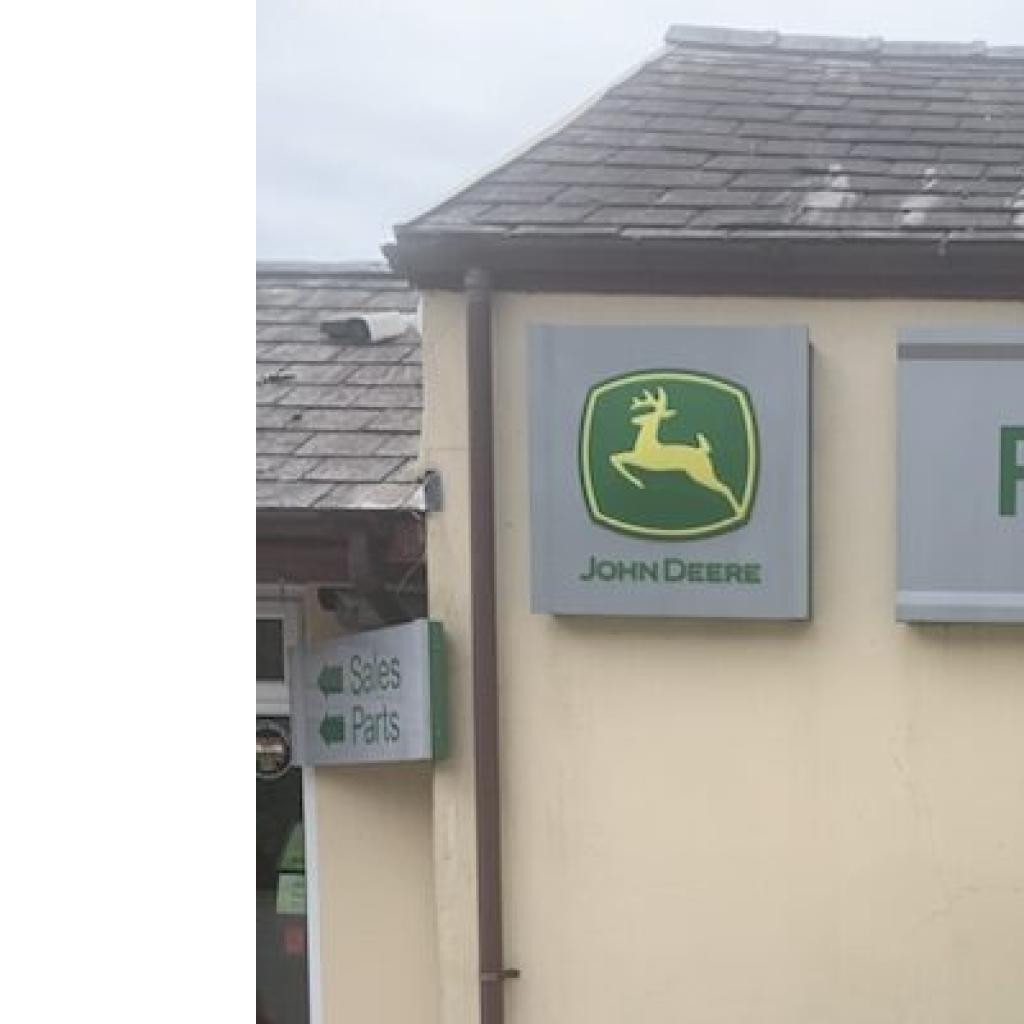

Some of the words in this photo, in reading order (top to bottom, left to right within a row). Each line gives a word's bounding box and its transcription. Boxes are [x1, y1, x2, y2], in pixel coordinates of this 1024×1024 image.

[580, 556, 659, 582] JOHN
[664, 557, 761, 584] DEERE
[350, 654, 402, 695] Sales
[352, 703, 401, 745] Parts
